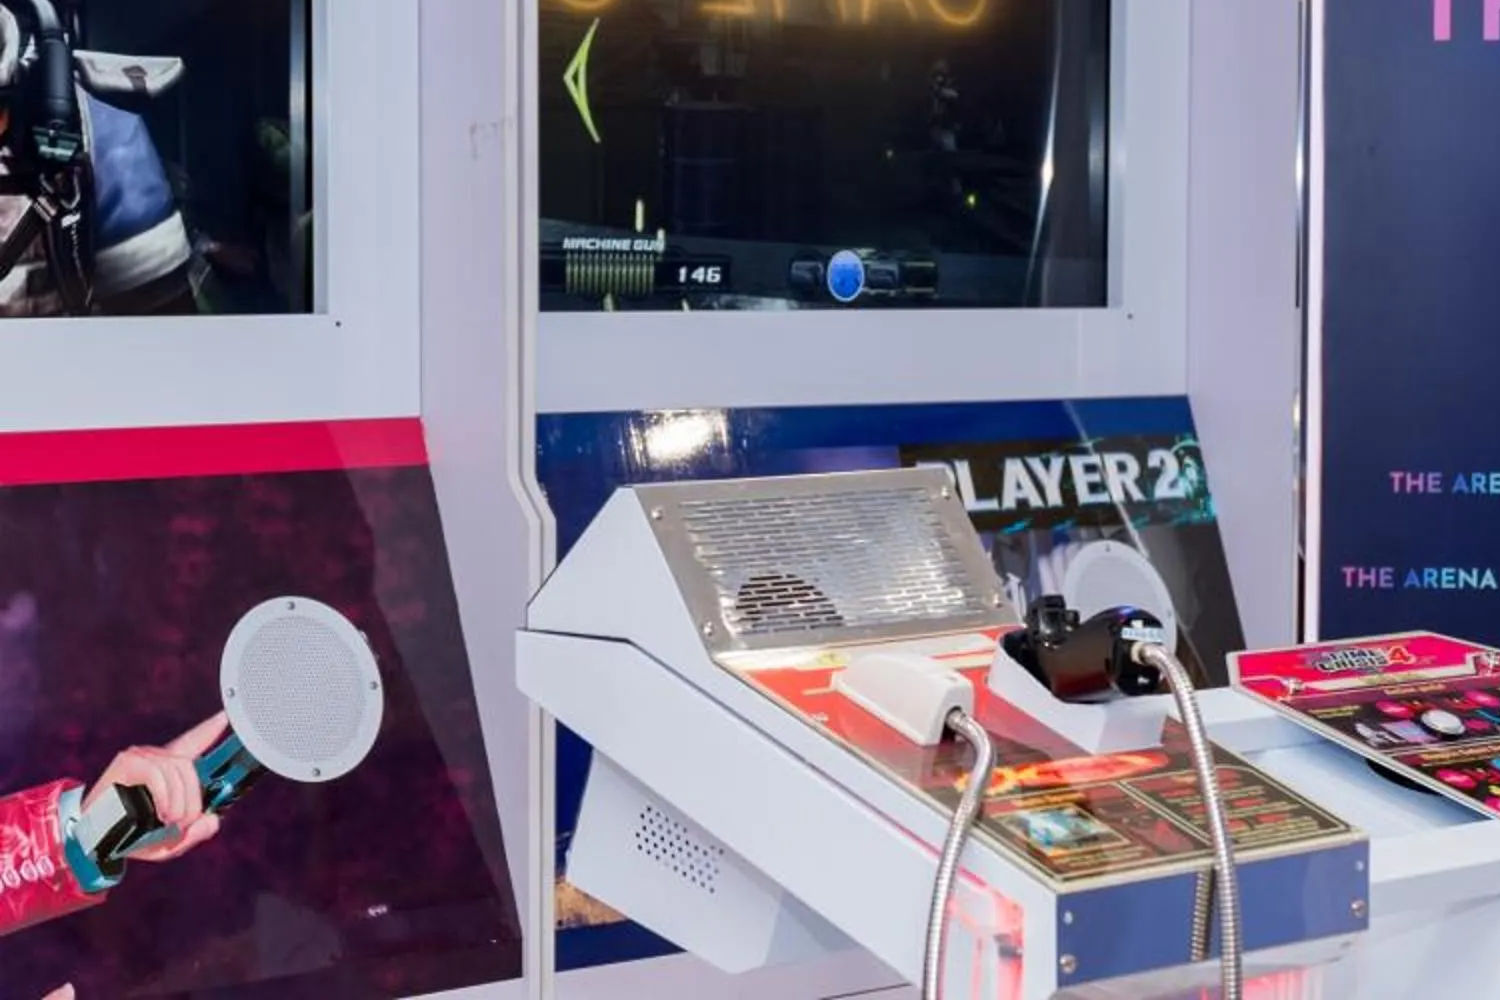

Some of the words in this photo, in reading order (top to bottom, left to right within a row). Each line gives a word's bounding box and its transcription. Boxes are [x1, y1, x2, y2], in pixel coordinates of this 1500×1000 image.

[562, 237, 632, 251] MACHINE
[678, 265, 722, 284] 146
[1147, 449, 1187, 499] 2
[1389, 471, 1443, 494] THE
[1341, 566, 1395, 589] THE
[1403, 567, 1498, 590] ARENA
